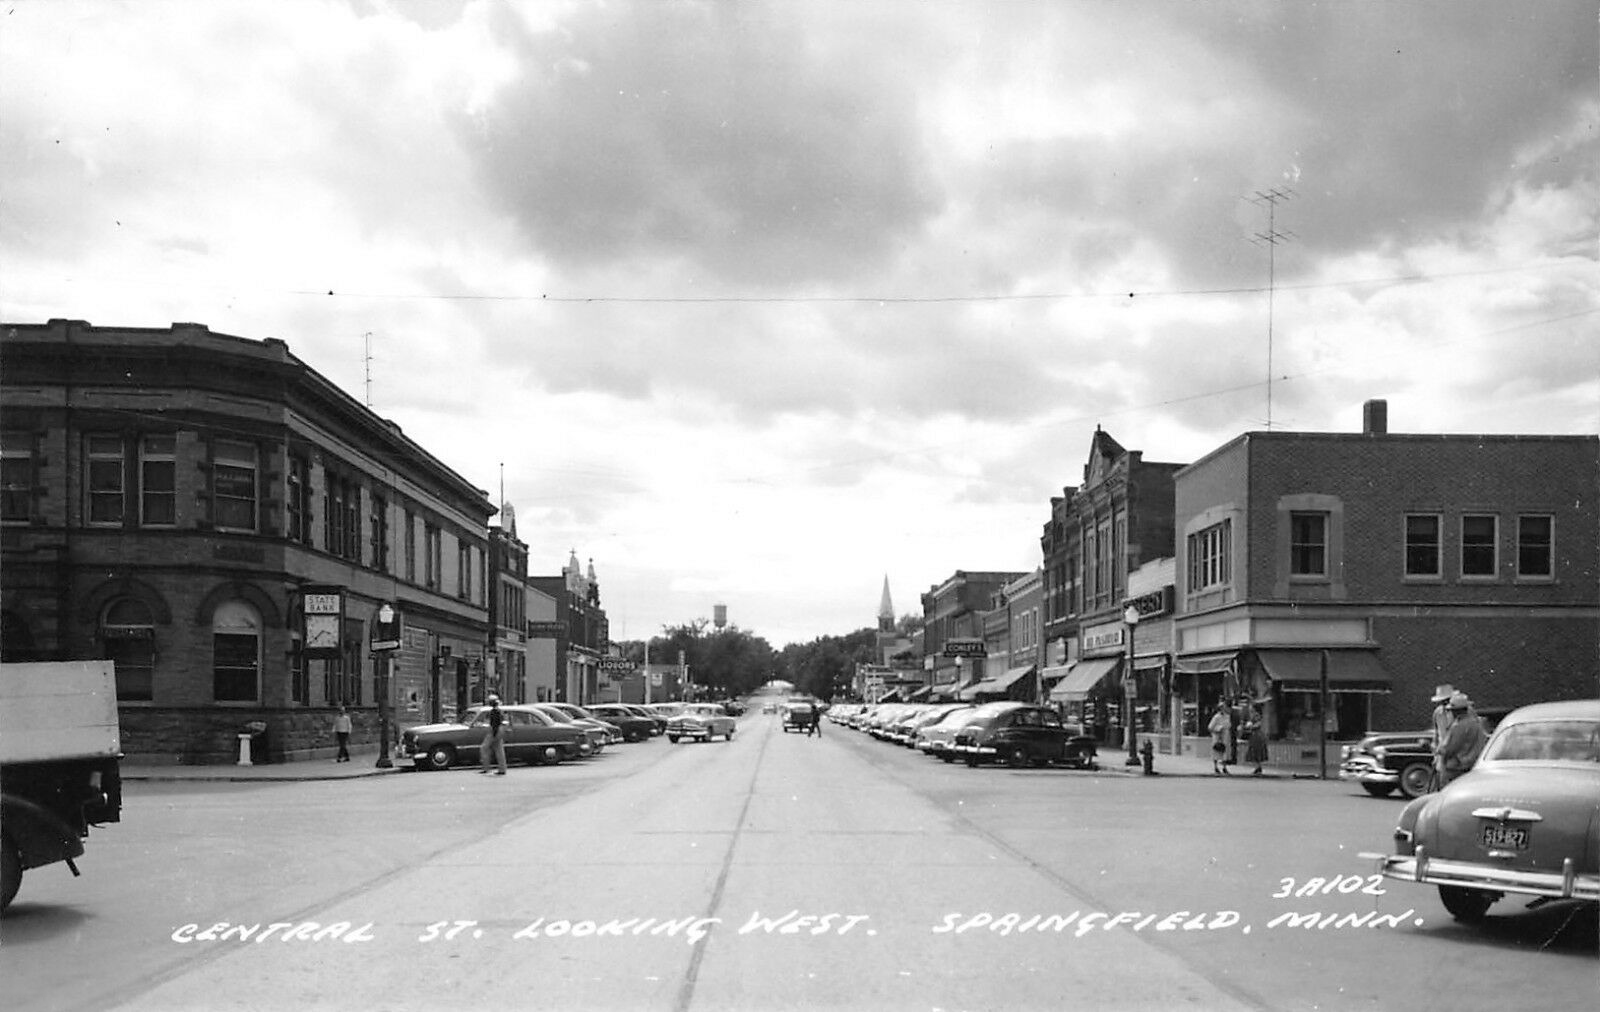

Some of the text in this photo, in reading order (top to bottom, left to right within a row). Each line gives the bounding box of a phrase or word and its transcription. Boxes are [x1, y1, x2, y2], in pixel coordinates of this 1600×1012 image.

[308, 596, 335, 604] STATE
[310, 604, 334, 612] BANK
[598, 661, 636, 670] LIQUORS
